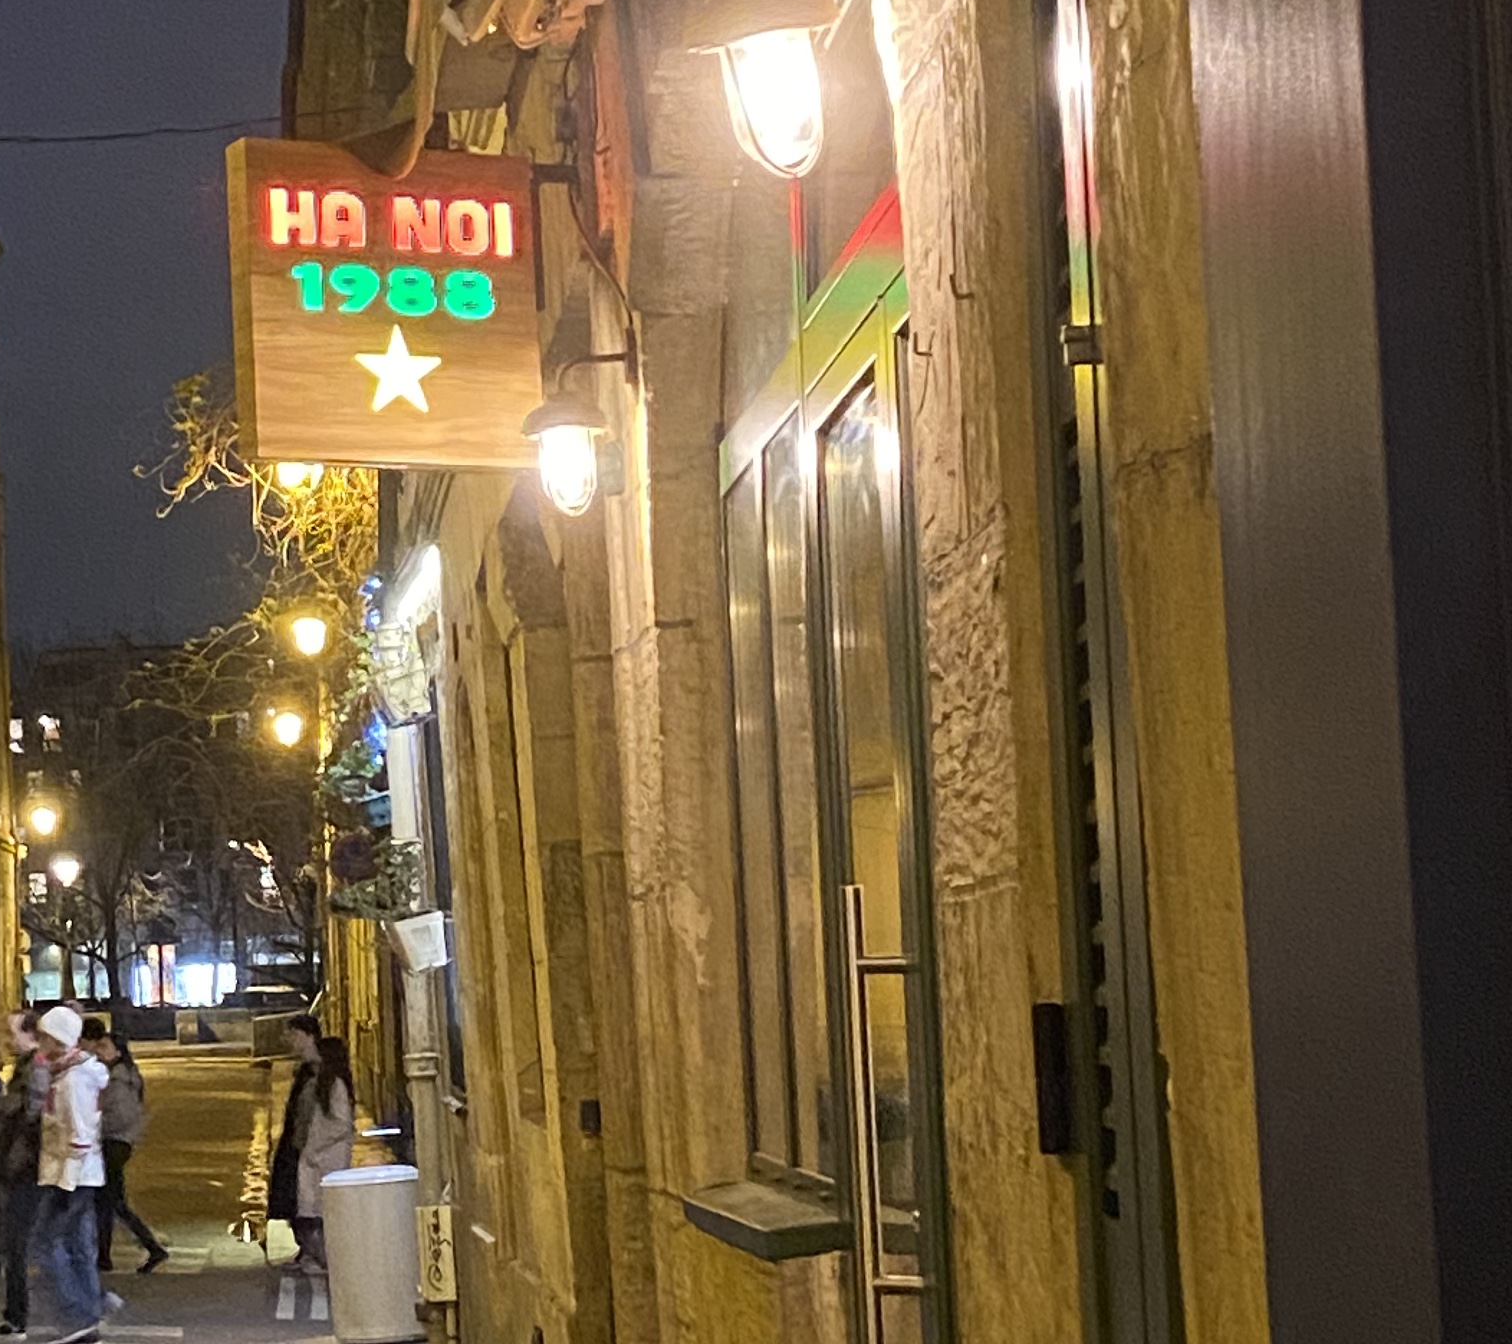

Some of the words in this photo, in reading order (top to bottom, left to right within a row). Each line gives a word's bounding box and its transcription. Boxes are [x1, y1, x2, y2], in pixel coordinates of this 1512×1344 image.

[267, 187, 367, 248] HA
[392, 196, 513, 257] NOI
[290, 260, 497, 321] 1988
